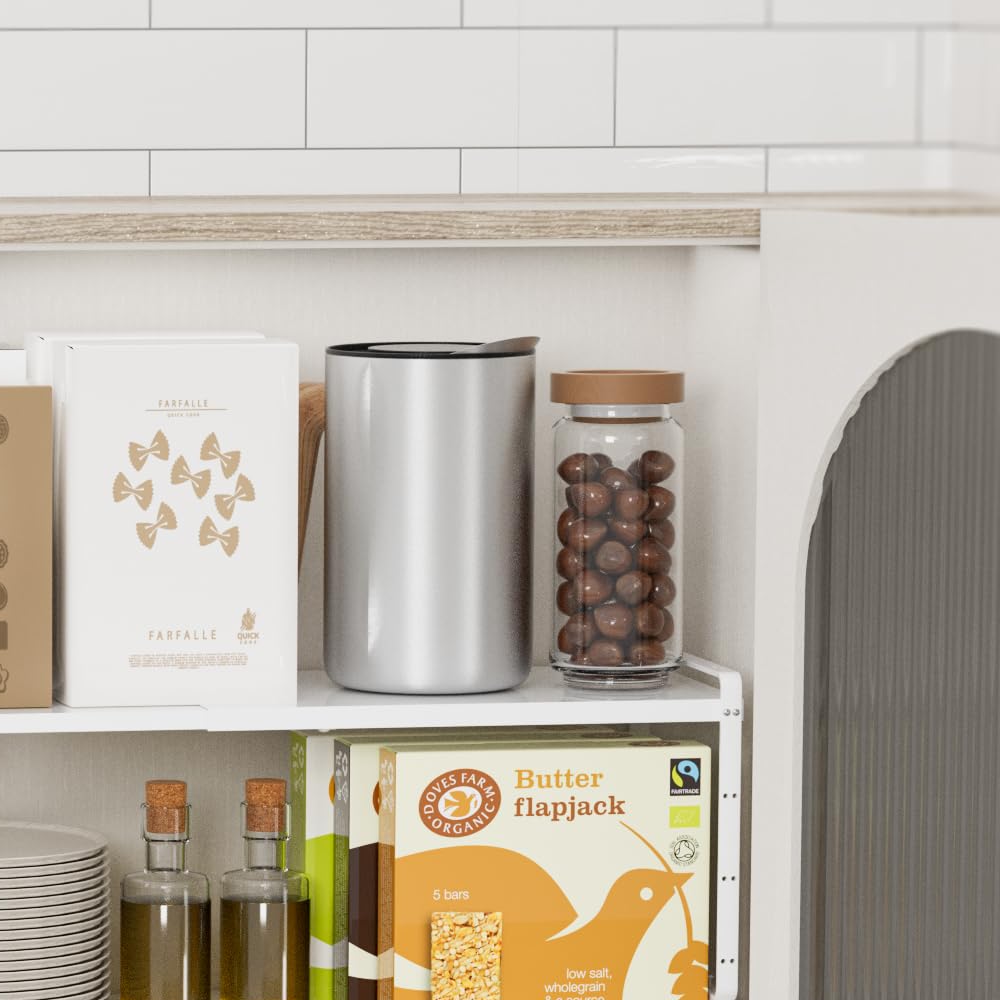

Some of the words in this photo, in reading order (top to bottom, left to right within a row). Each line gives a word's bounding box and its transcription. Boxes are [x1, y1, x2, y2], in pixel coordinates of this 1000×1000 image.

[158, 399, 209, 408] FARFALLE
[148, 629, 217, 640] FARFALLE
[237, 632, 260, 640] QUICK
[514, 768, 604, 789] Butter
[423, 774, 457, 815] DOVES
[461, 772, 496, 799] FARM
[514, 795, 626, 822] flapjack
[431, 802, 495, 834] ORGANIC
[432, 889, 441, 901] 5
[443, 888, 470, 901] bars
[566, 967, 587, 979] low
[589, 967, 612, 980] salt,
[544, 981, 606, 995] wholegrain
